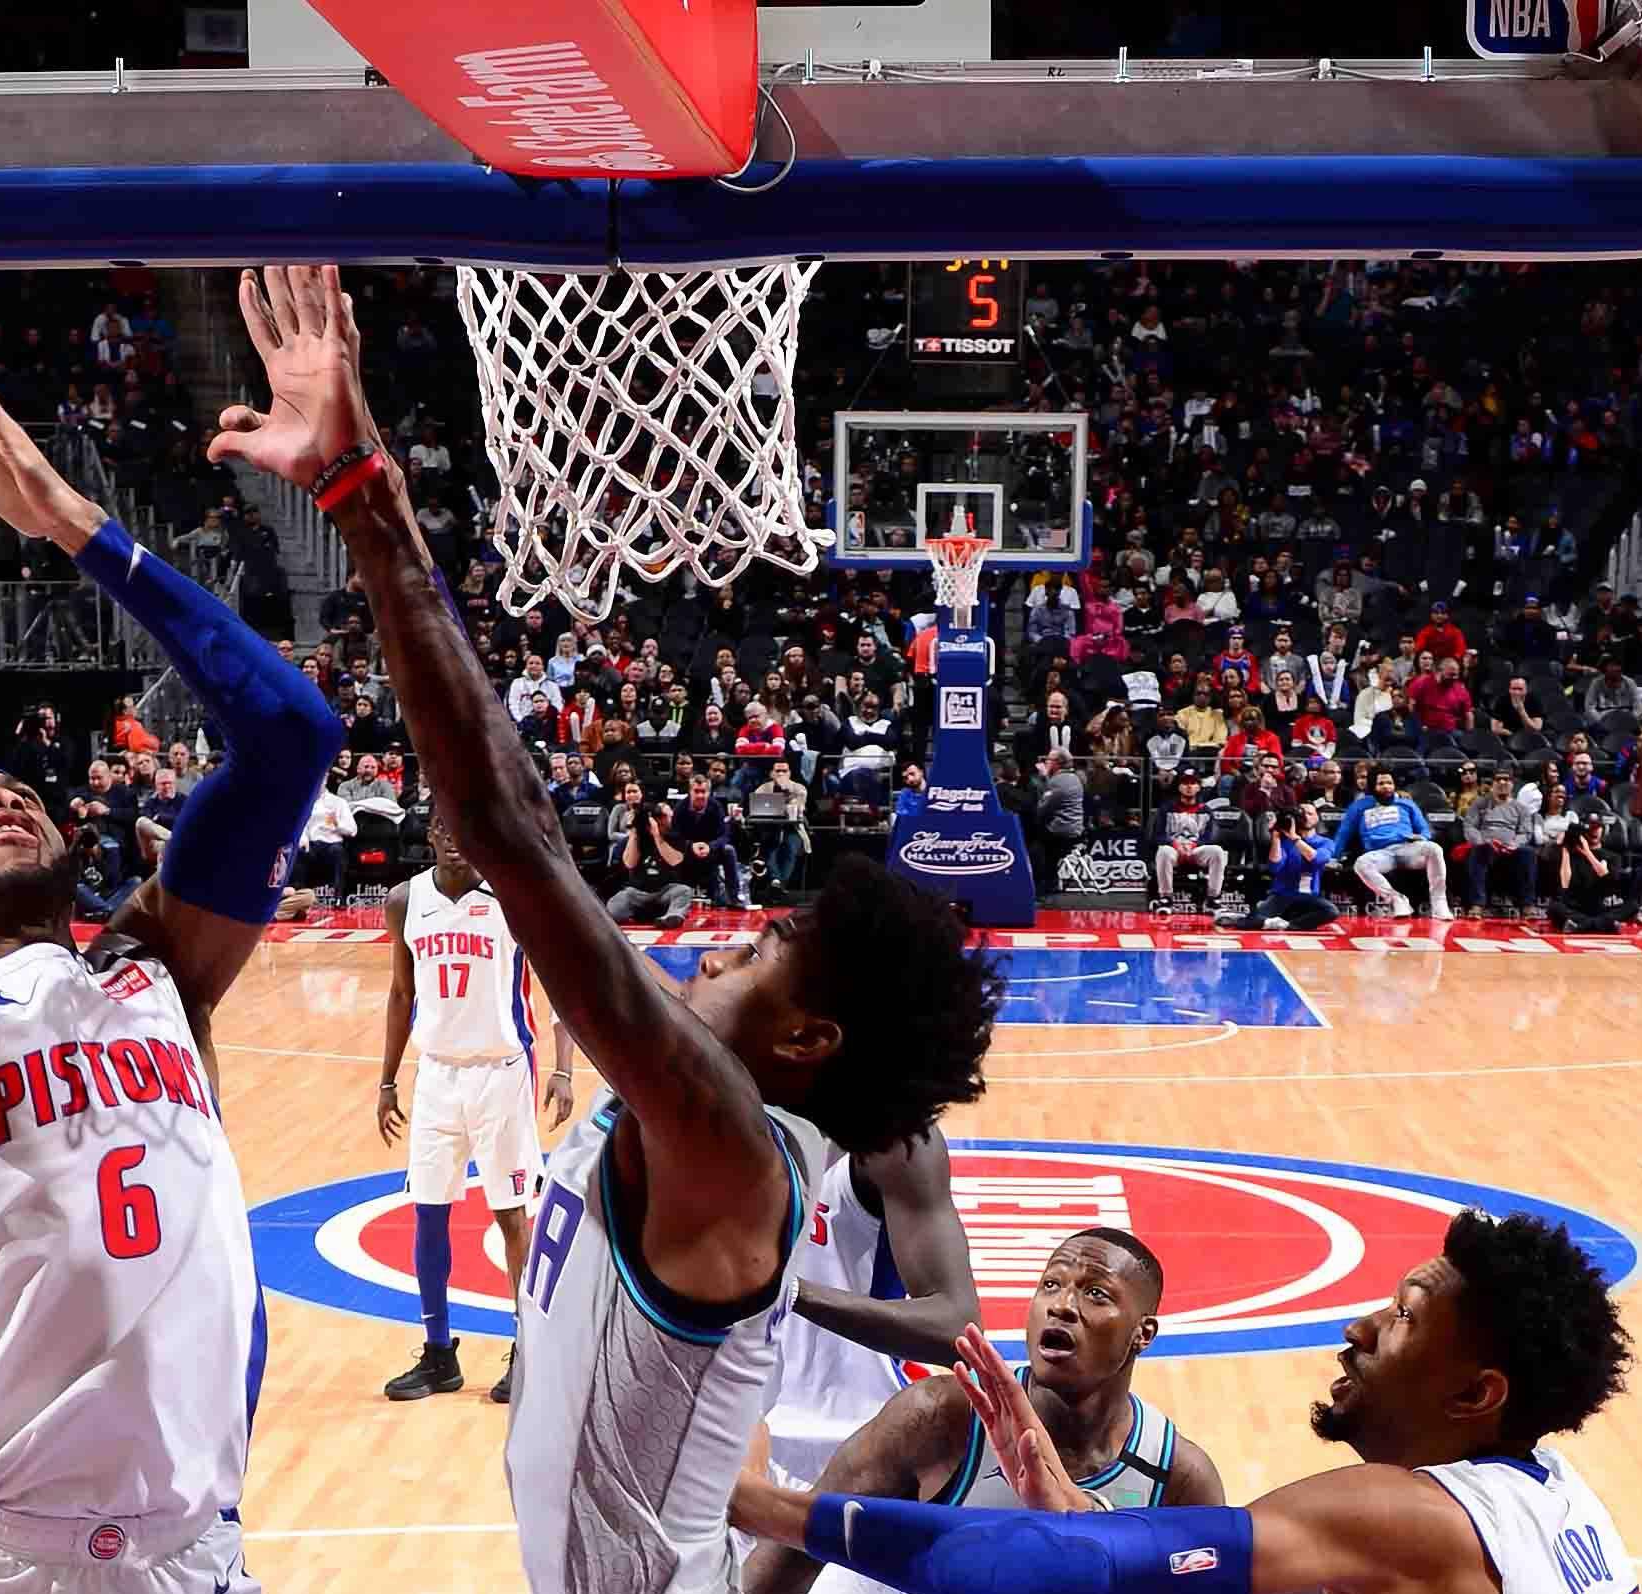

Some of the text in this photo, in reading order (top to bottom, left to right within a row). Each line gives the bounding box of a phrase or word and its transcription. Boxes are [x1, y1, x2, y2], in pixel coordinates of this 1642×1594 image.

[1489, 0, 1550, 37] NBA
[968, 275, 998, 328] 5
[941, 338, 1015, 353] TISSOT
[928, 787, 990, 803] Flagstar
[912, 832, 1006, 854] Henry Ford
[1091, 840, 1137, 857] AKE
[907, 852, 1009, 862] HEALTH SYSTEM
[357, 883, 388, 897] Little
[346, 893, 387, 908] Caesar
[413, 932, 494, 960] PISTONS
[438, 963, 470, 998] 17
[97, 1143, 161, 1260] 6
